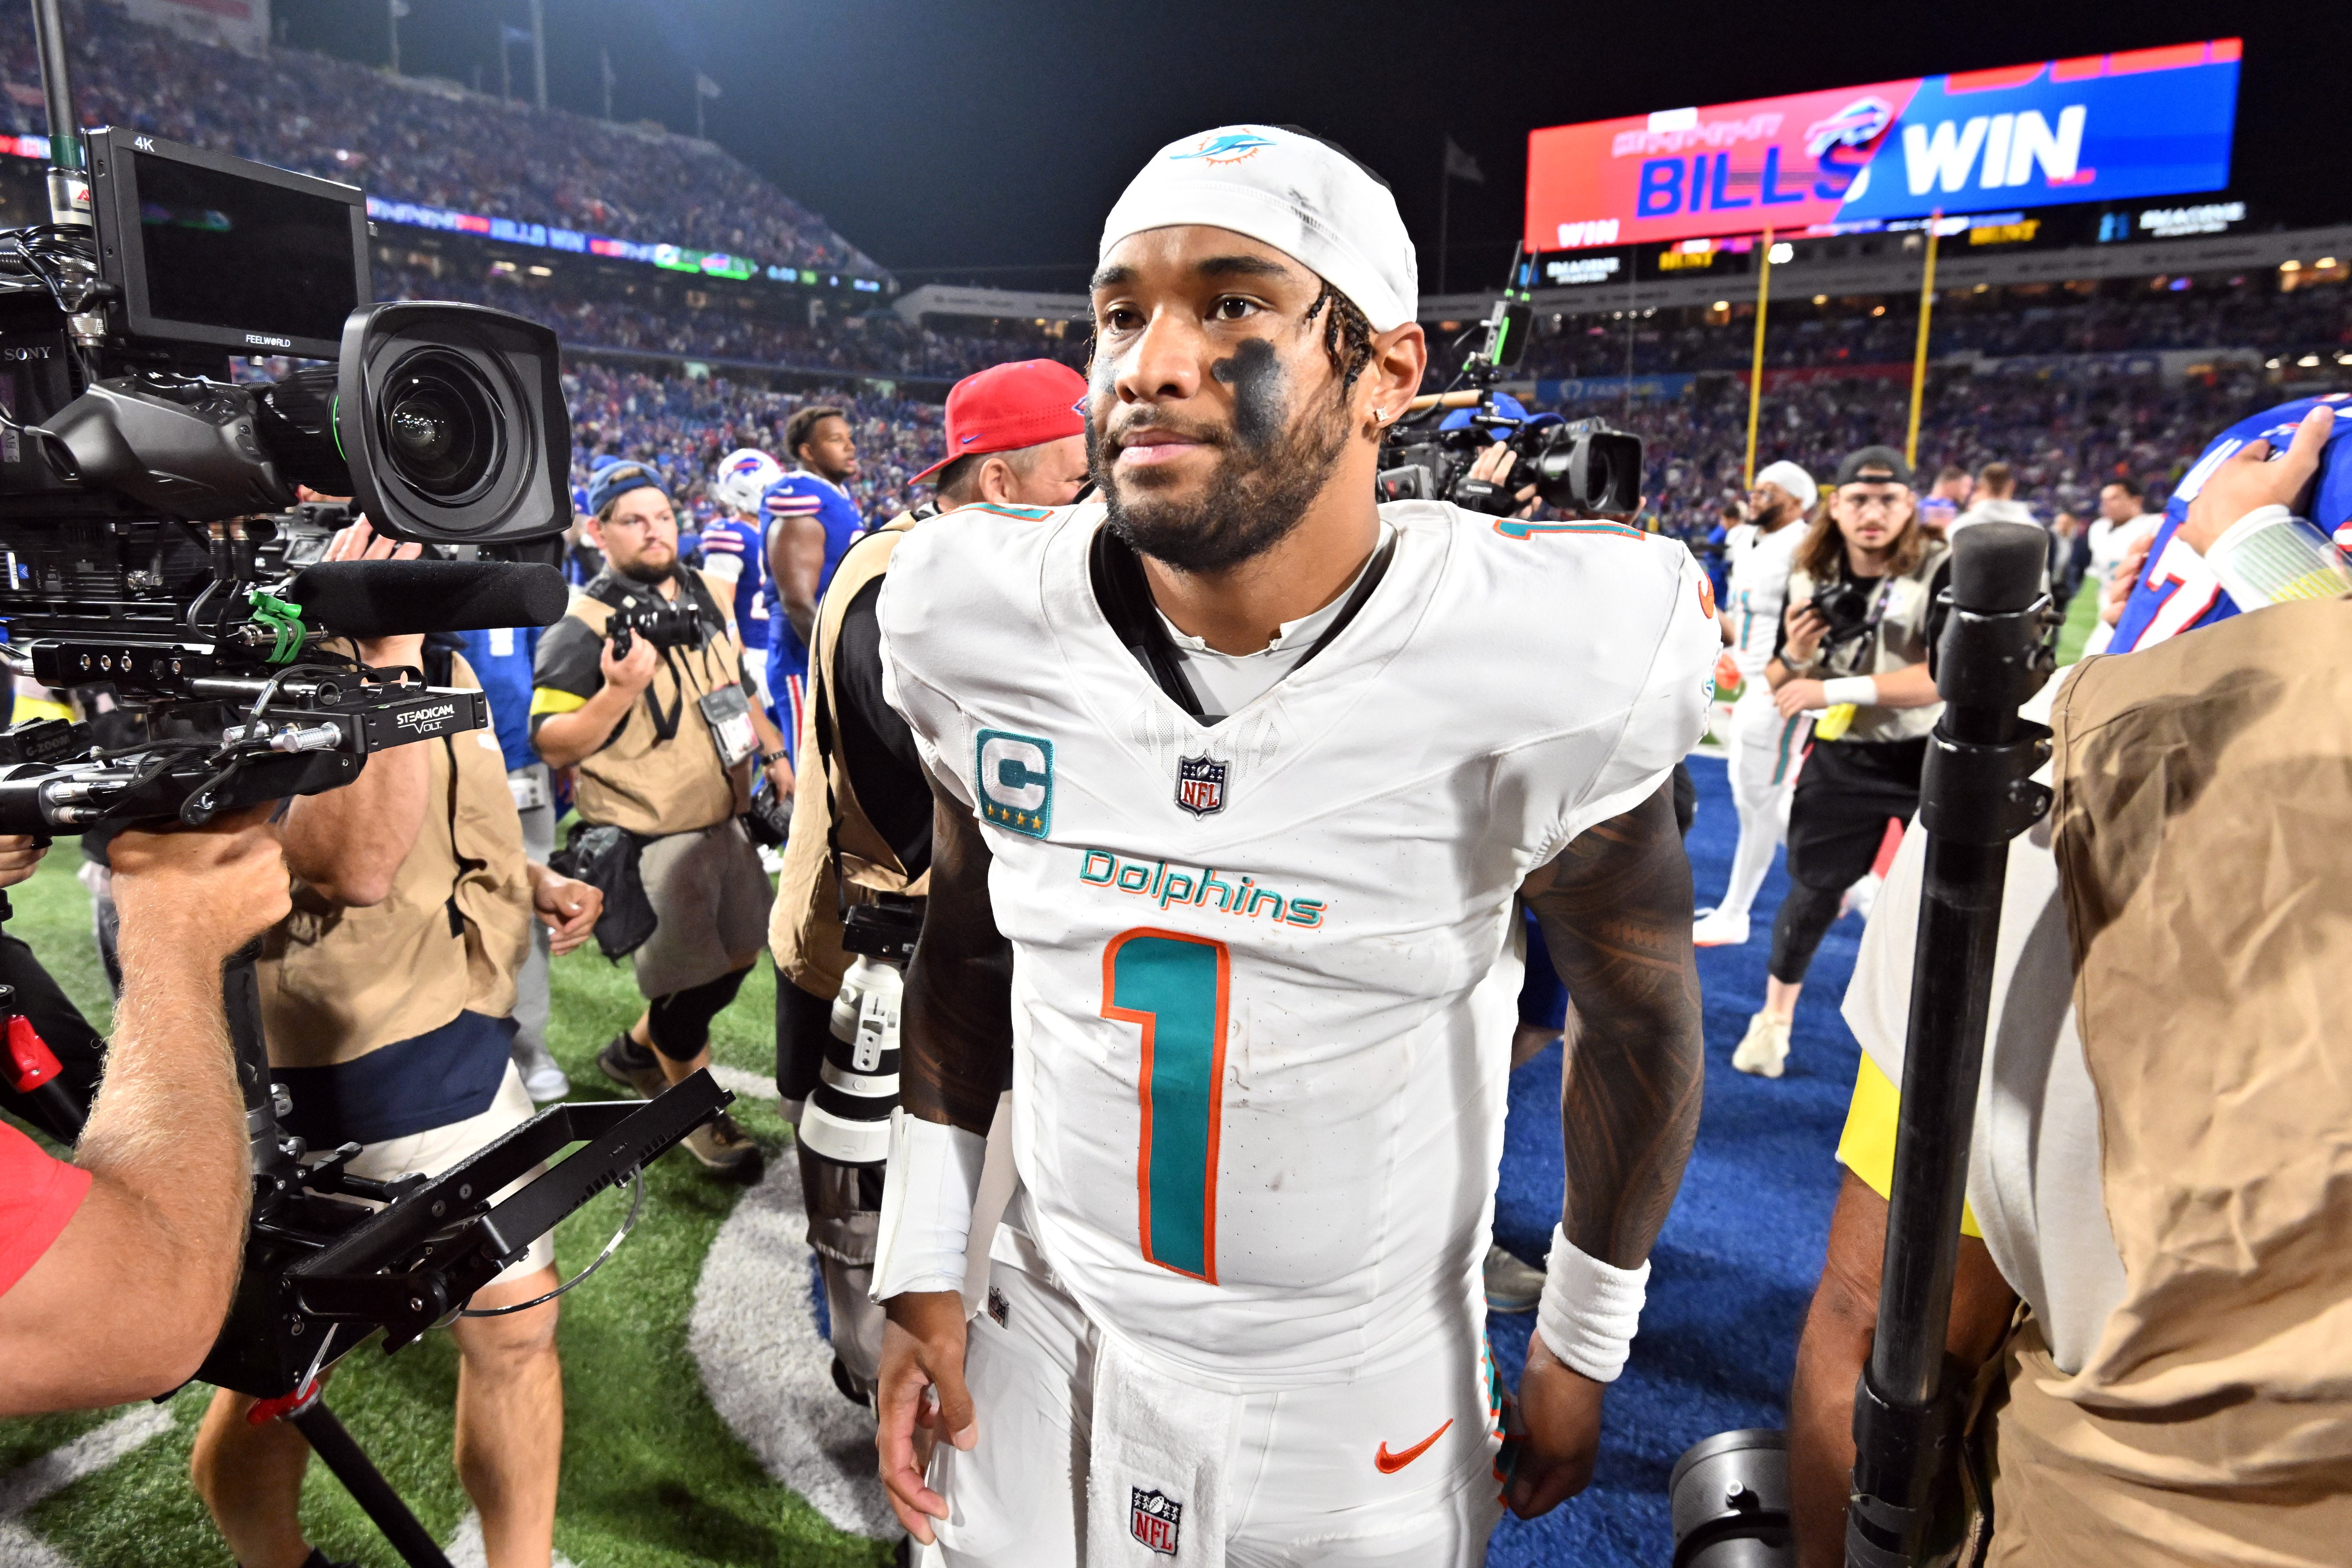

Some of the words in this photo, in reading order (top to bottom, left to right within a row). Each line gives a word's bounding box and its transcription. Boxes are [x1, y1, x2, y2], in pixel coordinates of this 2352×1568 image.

[134, 136, 155, 152] 4K
[1902, 104, 2086, 196] WIN
[1636, 139, 1870, 218] BILLS
[1557, 219, 1620, 248] WIN
[4, 346, 52, 361] SONY
[246, 334, 291, 347] FEELWORLD
[1467, 484, 1492, 494] FUJINON
[397, 704, 455, 725] STEADICAM
[982, 738, 1046, 811] C
[1182, 780, 1218, 809] NFL
[1080, 849, 1327, 928] Dolphins
[1100, 925, 1231, 1286] 1
[1135, 1511, 1173, 1551] NFL
